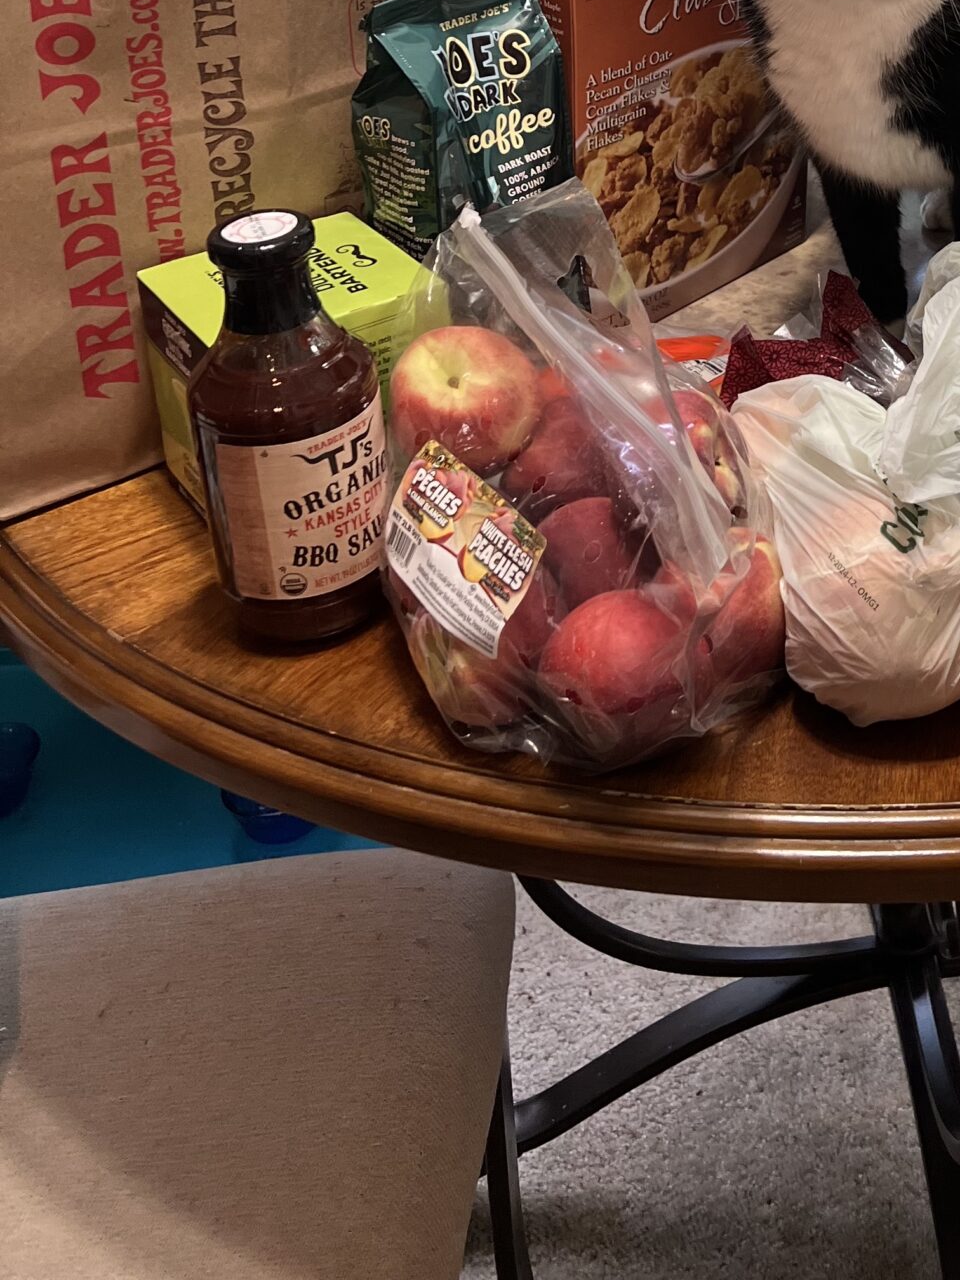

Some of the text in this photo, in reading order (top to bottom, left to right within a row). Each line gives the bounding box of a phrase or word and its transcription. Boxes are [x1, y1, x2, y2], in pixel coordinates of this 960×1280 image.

[439, 14, 479, 32] TRADER
[585, 50, 673, 89] A blend of Oat-
[585, 85, 620, 105] Pecan
[585, 79, 671, 120] Corn Flakes &
[468, 108, 556, 155] coffee
[586, 106, 647, 138] Multigrain
[197, 55, 255, 228] RECYCLE
[586, 130, 624, 152] Flakes
[498, 146, 552, 174] DARK ROAST
[504, 171, 529, 187] 100%
[507, 176, 546, 197] GROUND
[50, 131, 142, 400] TRADER
[307, 432, 345, 454] TRADER
[283, 450, 388, 521] ORGANIC
[412, 467, 463, 516] PÊCHES
[304, 479, 384, 532] KANSAS CITY
[334, 507, 372, 540] STYLE
[291, 542, 339, 568] BBQ
[480, 518, 534, 574] WHITE FLESH
[468, 536, 527, 592] PEACHES
[314, 577, 329, 589] NET
[857, 587, 880, 612] OMG1
